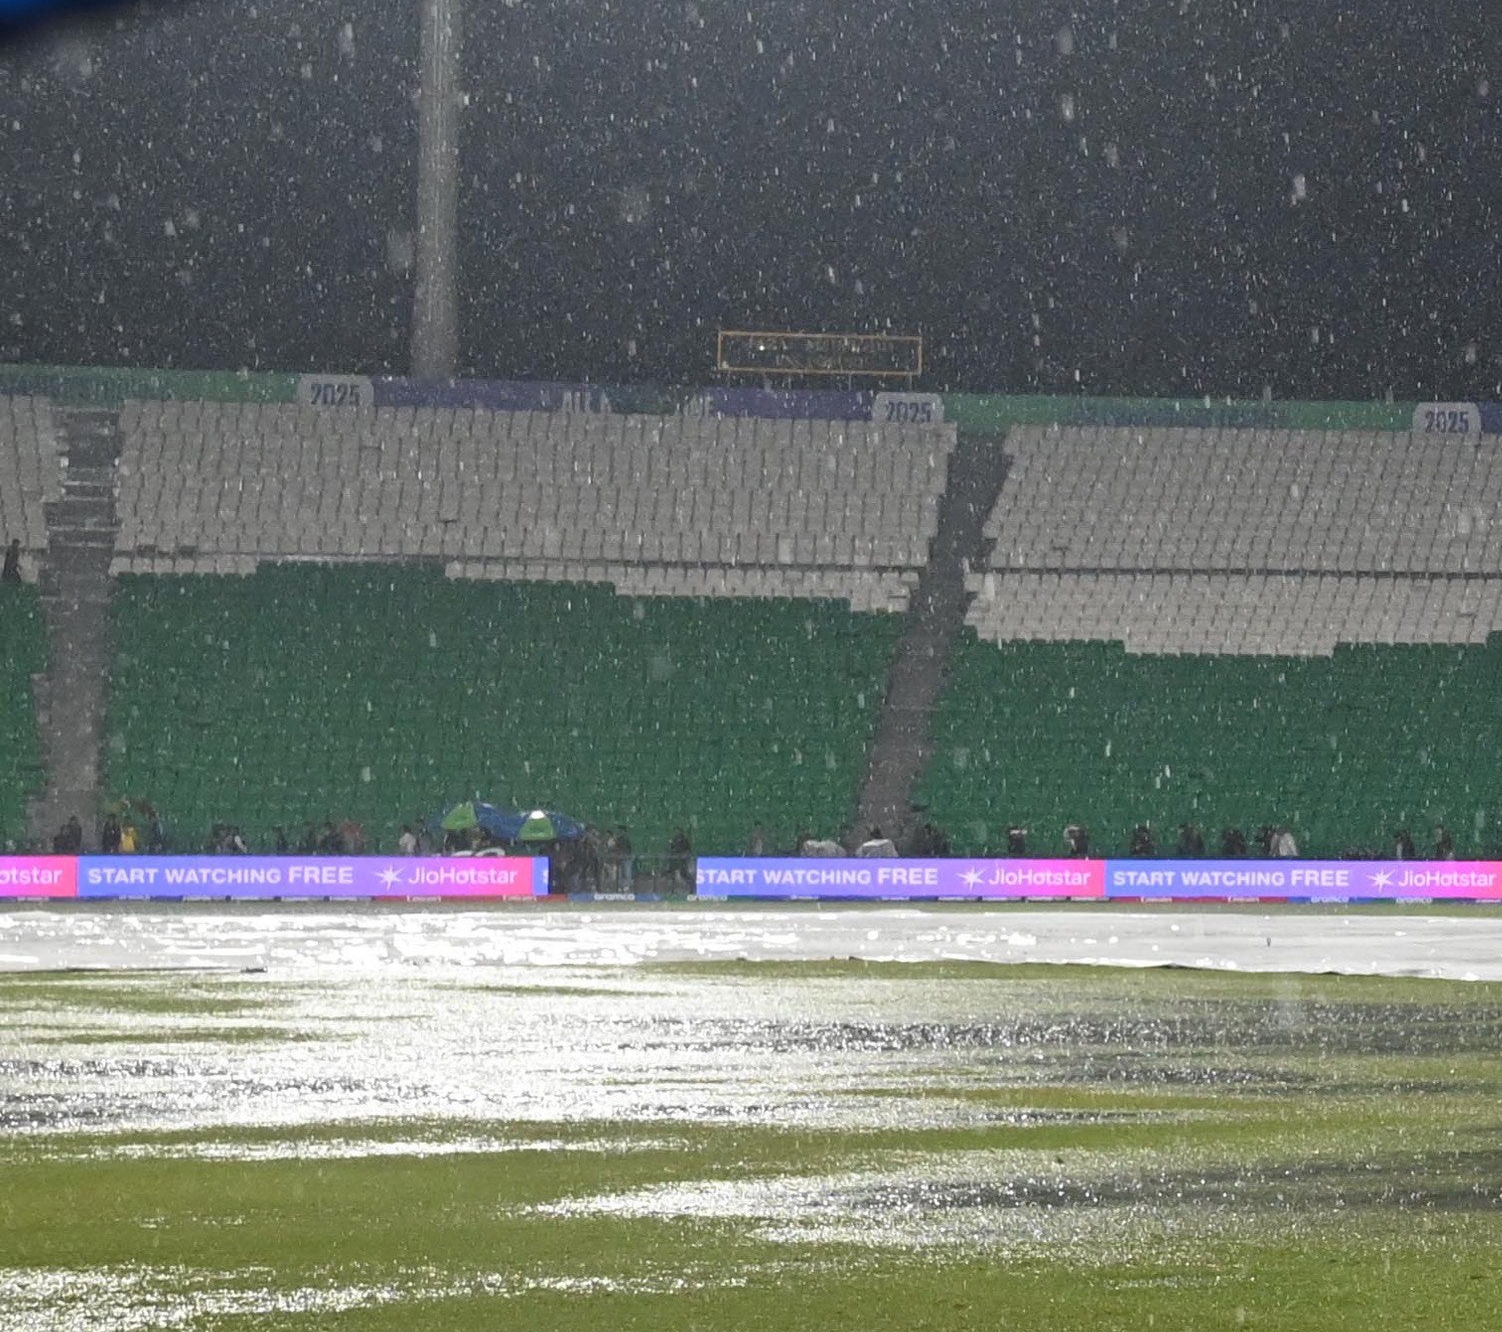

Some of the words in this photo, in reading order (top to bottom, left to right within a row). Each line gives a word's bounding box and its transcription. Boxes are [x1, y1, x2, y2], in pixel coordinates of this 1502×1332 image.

[311, 383, 361, 405] 2025
[884, 401, 932, 423] 2025
[1425, 411, 1470, 433] 2025
[88, 867, 159, 884] START
[164, 868, 281, 884] WATCHING
[288, 865, 353, 884] FREE
[408, 866, 518, 885] JioHotstar
[696, 868, 757, 885] START
[762, 869, 871, 885] WATCHING
[877, 867, 938, 885] FREE
[988, 868, 1091, 886] JioHotstar
[1113, 870, 1174, 886] START
[1180, 871, 1285, 887] WATCHING
[1290, 869, 1349, 887] FREE
[1397, 870, 1497, 887] JioHotstar
[594, 892, 635, 901] aramco
